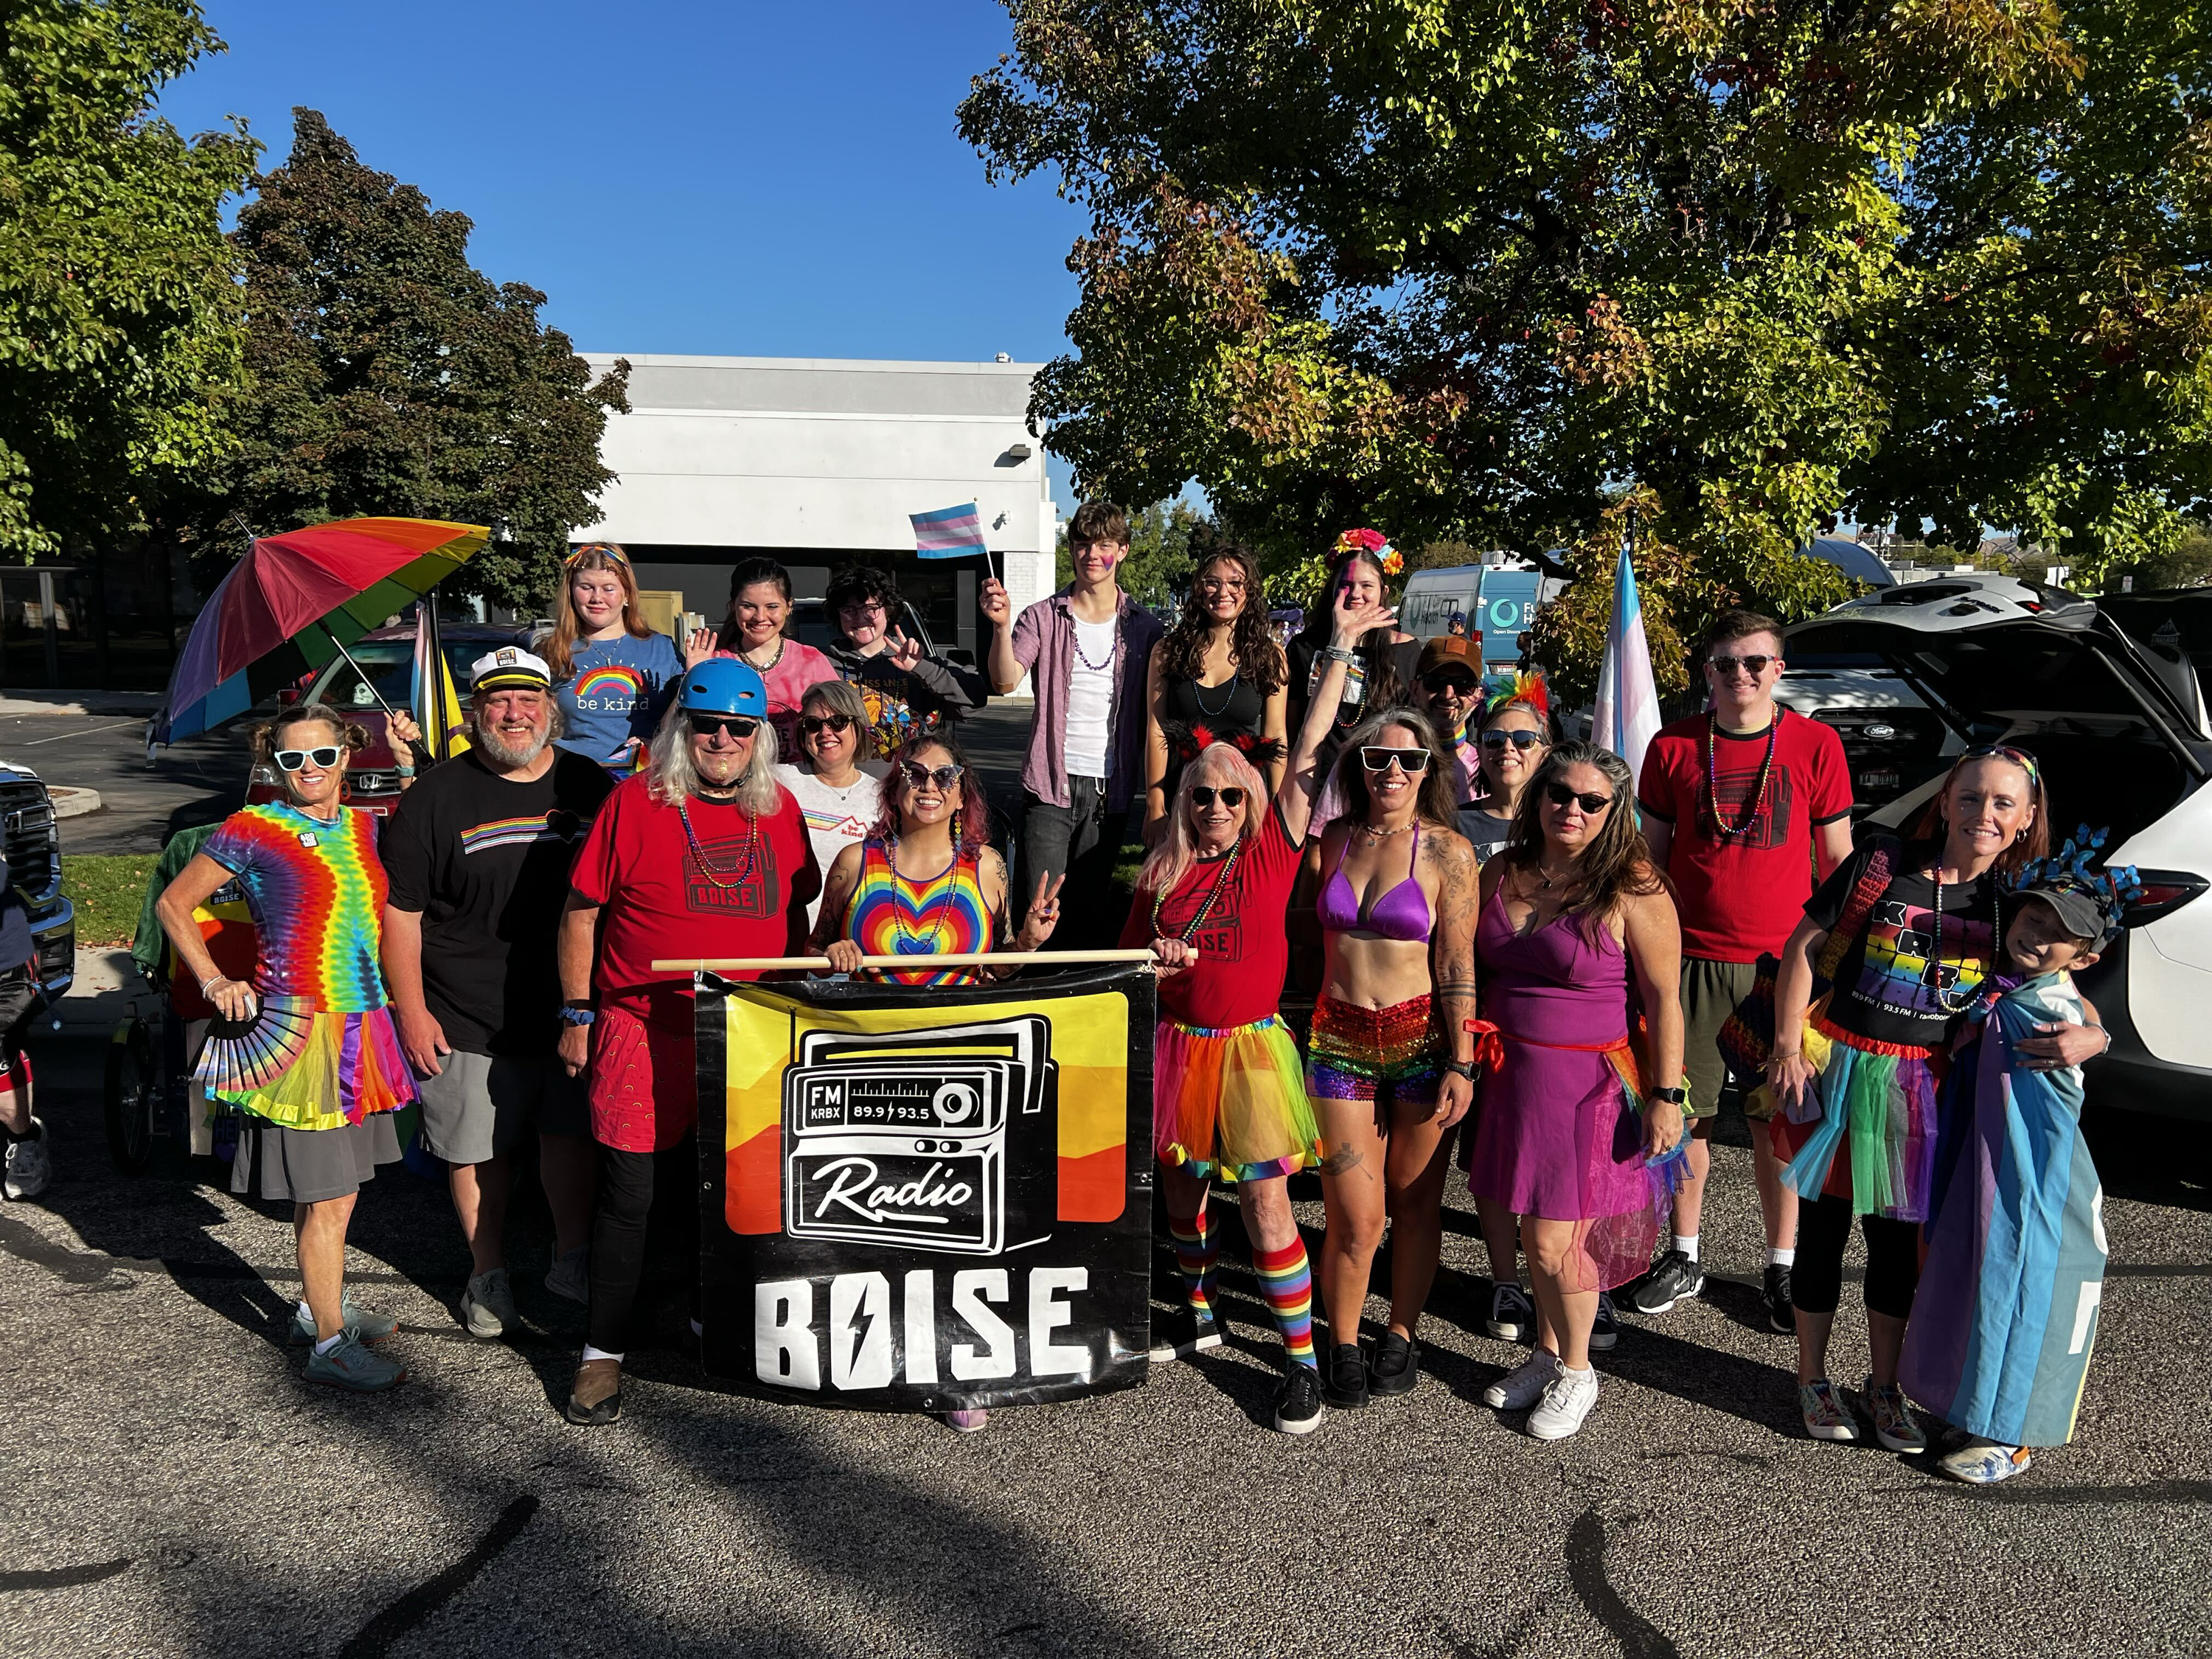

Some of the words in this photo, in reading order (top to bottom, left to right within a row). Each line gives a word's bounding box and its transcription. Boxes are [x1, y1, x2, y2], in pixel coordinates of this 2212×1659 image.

[577, 695, 597, 710] be
[604, 697, 649, 711] kind
[1870, 726, 1888, 735] Ford
[841, 828, 863, 838] kind
[847, 824, 858, 832] be
[214, 893, 240, 904] BOISE
[698, 887, 754, 907] BOISE
[1851, 990, 1864, 1001] 89.9
[1864, 996, 1876, 1006] FM
[1883, 1004, 1899, 1014] 93.5
[1899, 1009, 1912, 1018] FM
[811, 1085, 841, 1106] FM
[811, 1107, 841, 1120] KRBX
[853, 1106, 885, 1118] 89.9
[897, 1107, 930, 1120] 93.5
[812, 1157, 973, 1223] Radio
[756, 1266, 1090, 1391] BOISE
